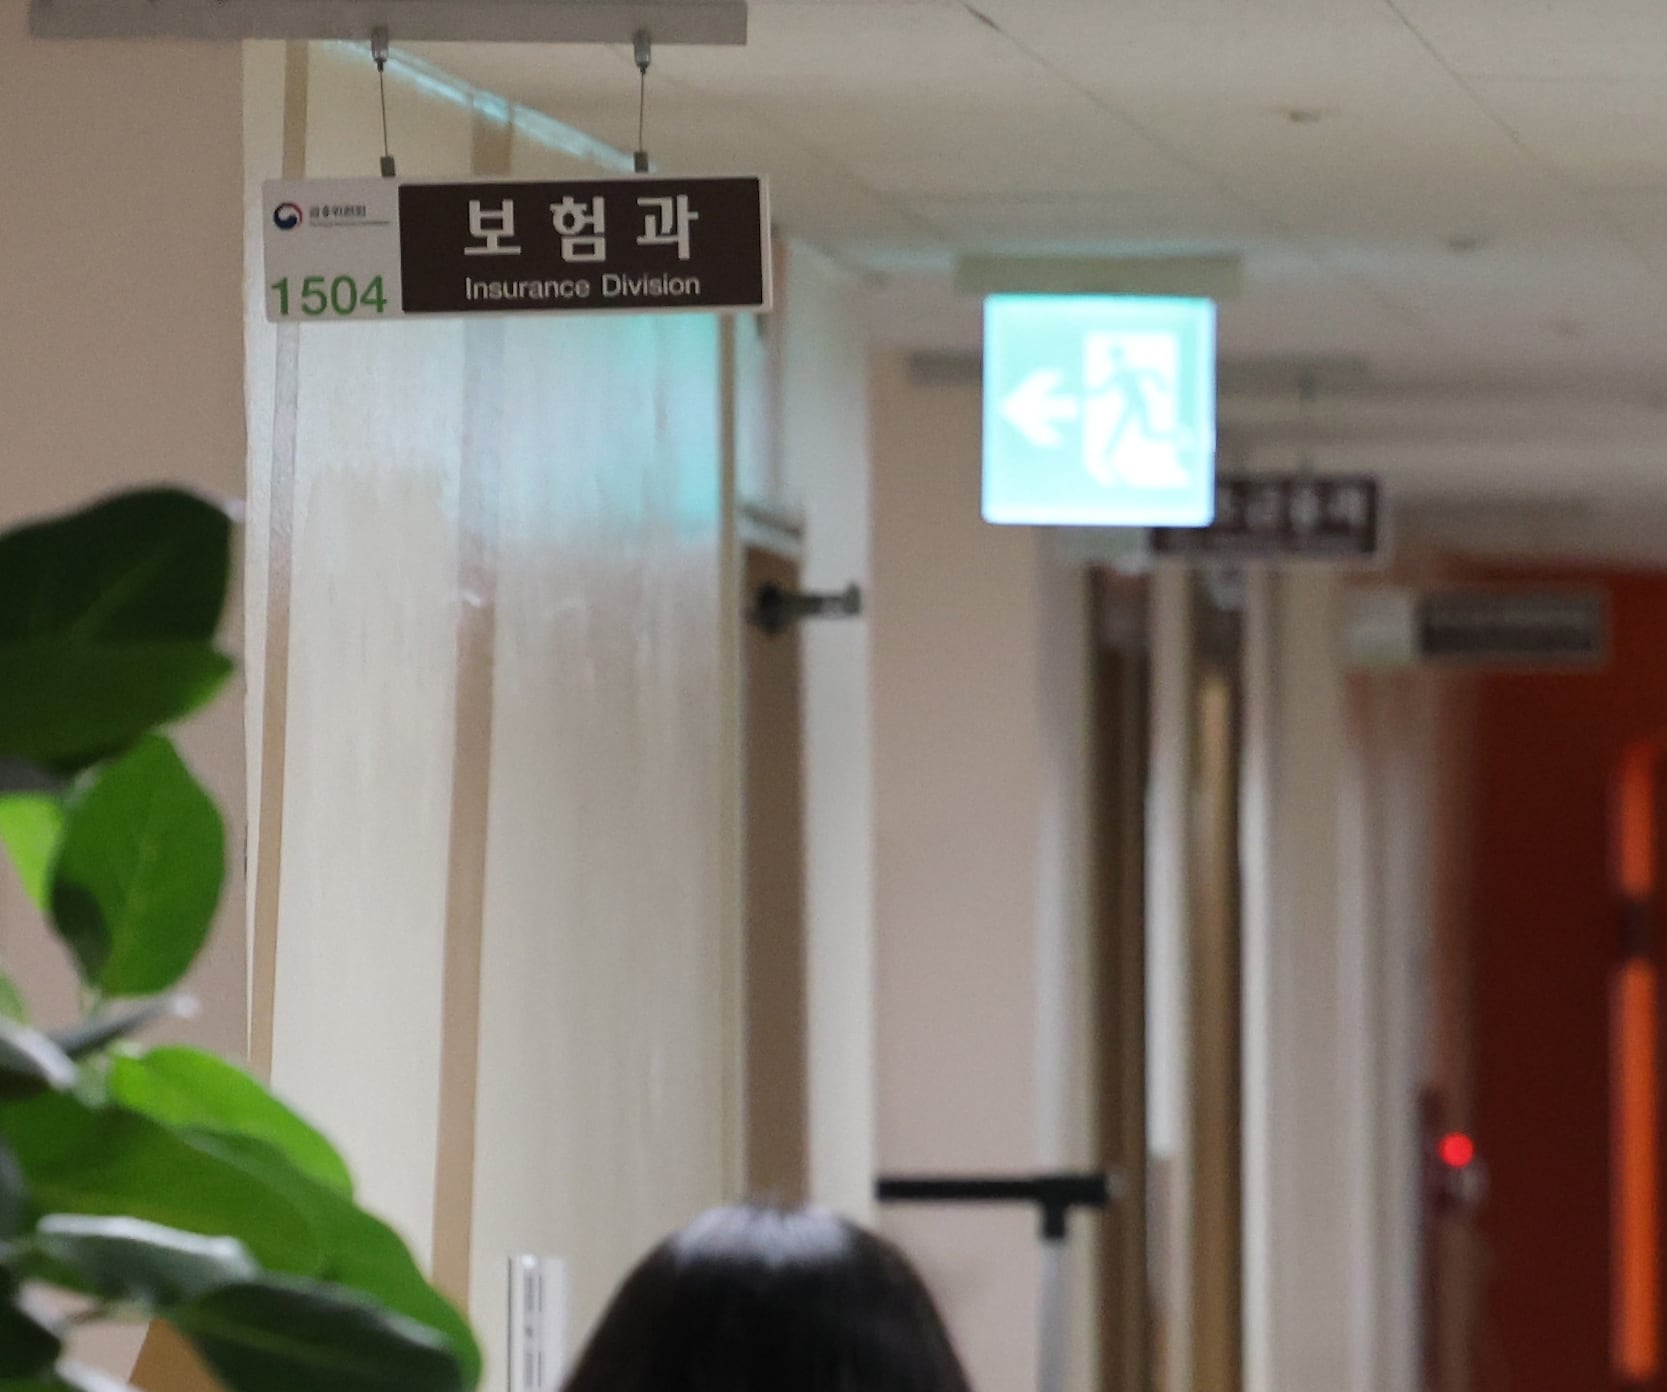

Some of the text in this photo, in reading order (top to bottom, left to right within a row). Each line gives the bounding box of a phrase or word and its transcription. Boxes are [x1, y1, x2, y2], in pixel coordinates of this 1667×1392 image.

[463, 194, 700, 263] 보험과
[271, 274, 389, 317] 1504
[464, 272, 700, 301] Insurance Division
